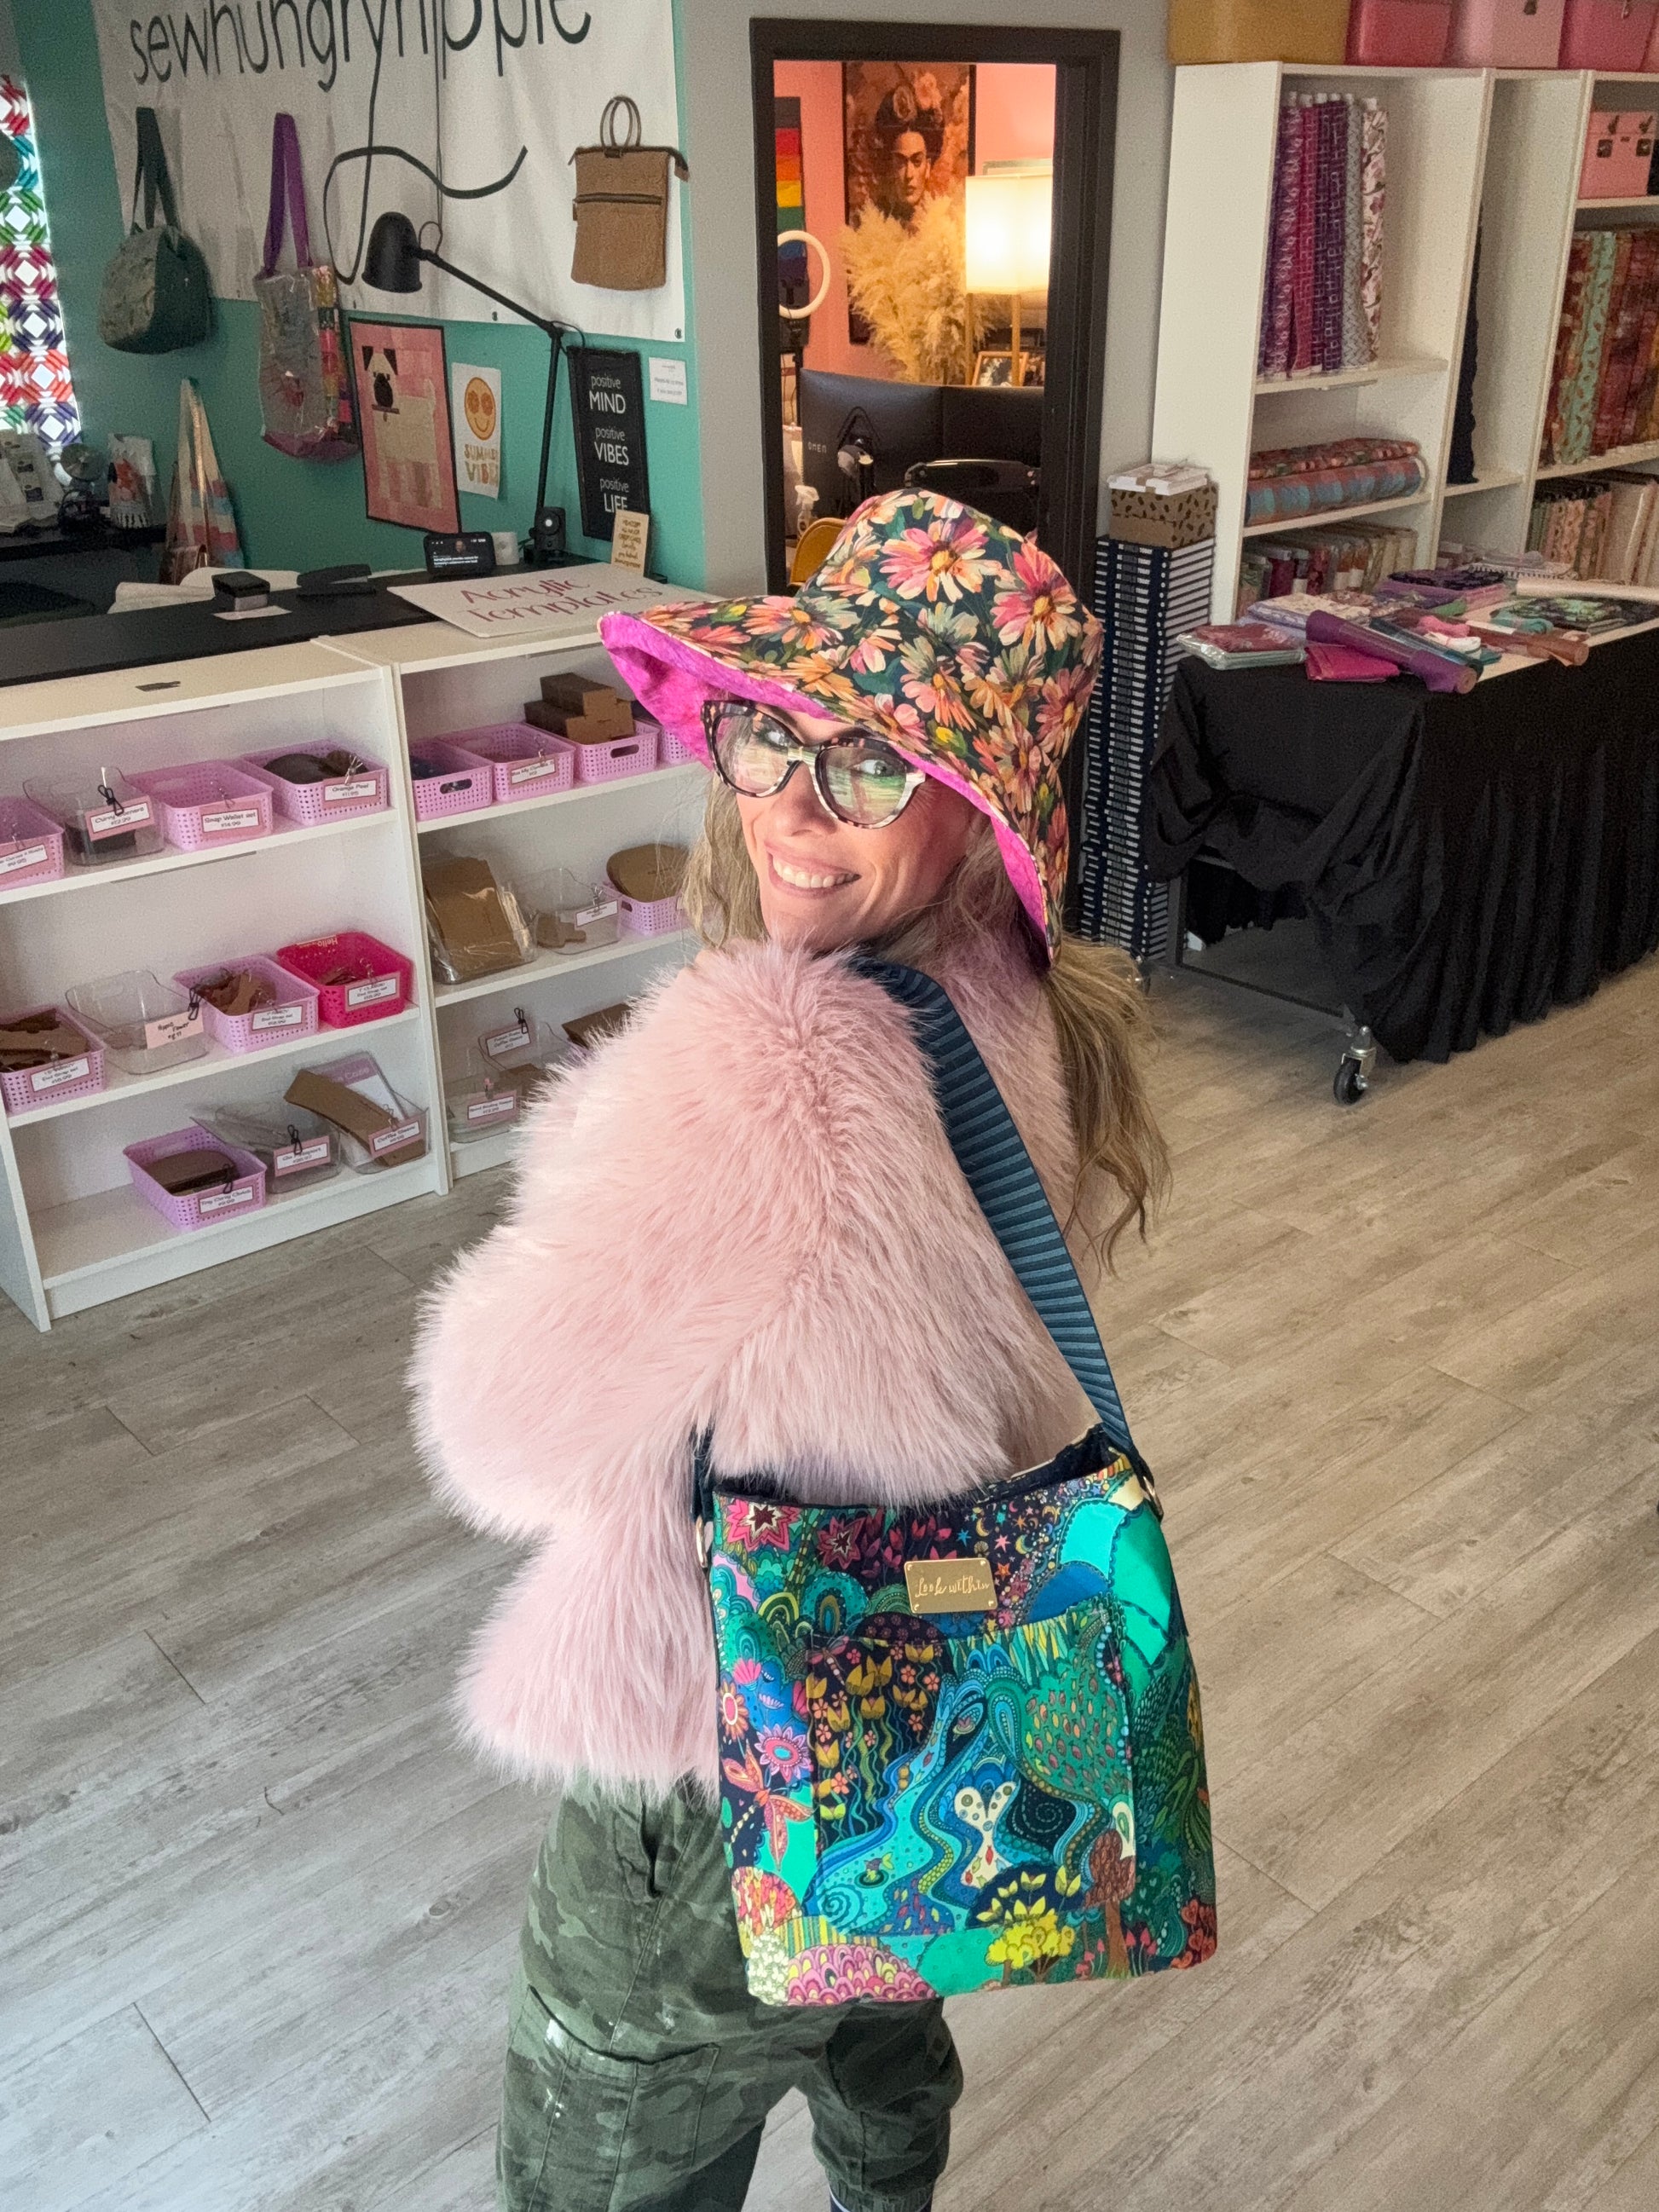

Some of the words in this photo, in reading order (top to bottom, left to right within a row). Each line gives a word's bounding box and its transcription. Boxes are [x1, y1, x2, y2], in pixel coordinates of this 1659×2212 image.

[591, 373, 621, 390] positive
[589, 390, 627, 414] MIND
[595, 426, 626, 442] positive
[593, 442, 629, 465] VIBES
[599, 477, 629, 493] positive
[460, 579, 591, 604] Acrylic
[458, 586, 663, 622] Templates
[915, 1576, 948, 1598] Look
[948, 1574, 991, 1595] within
